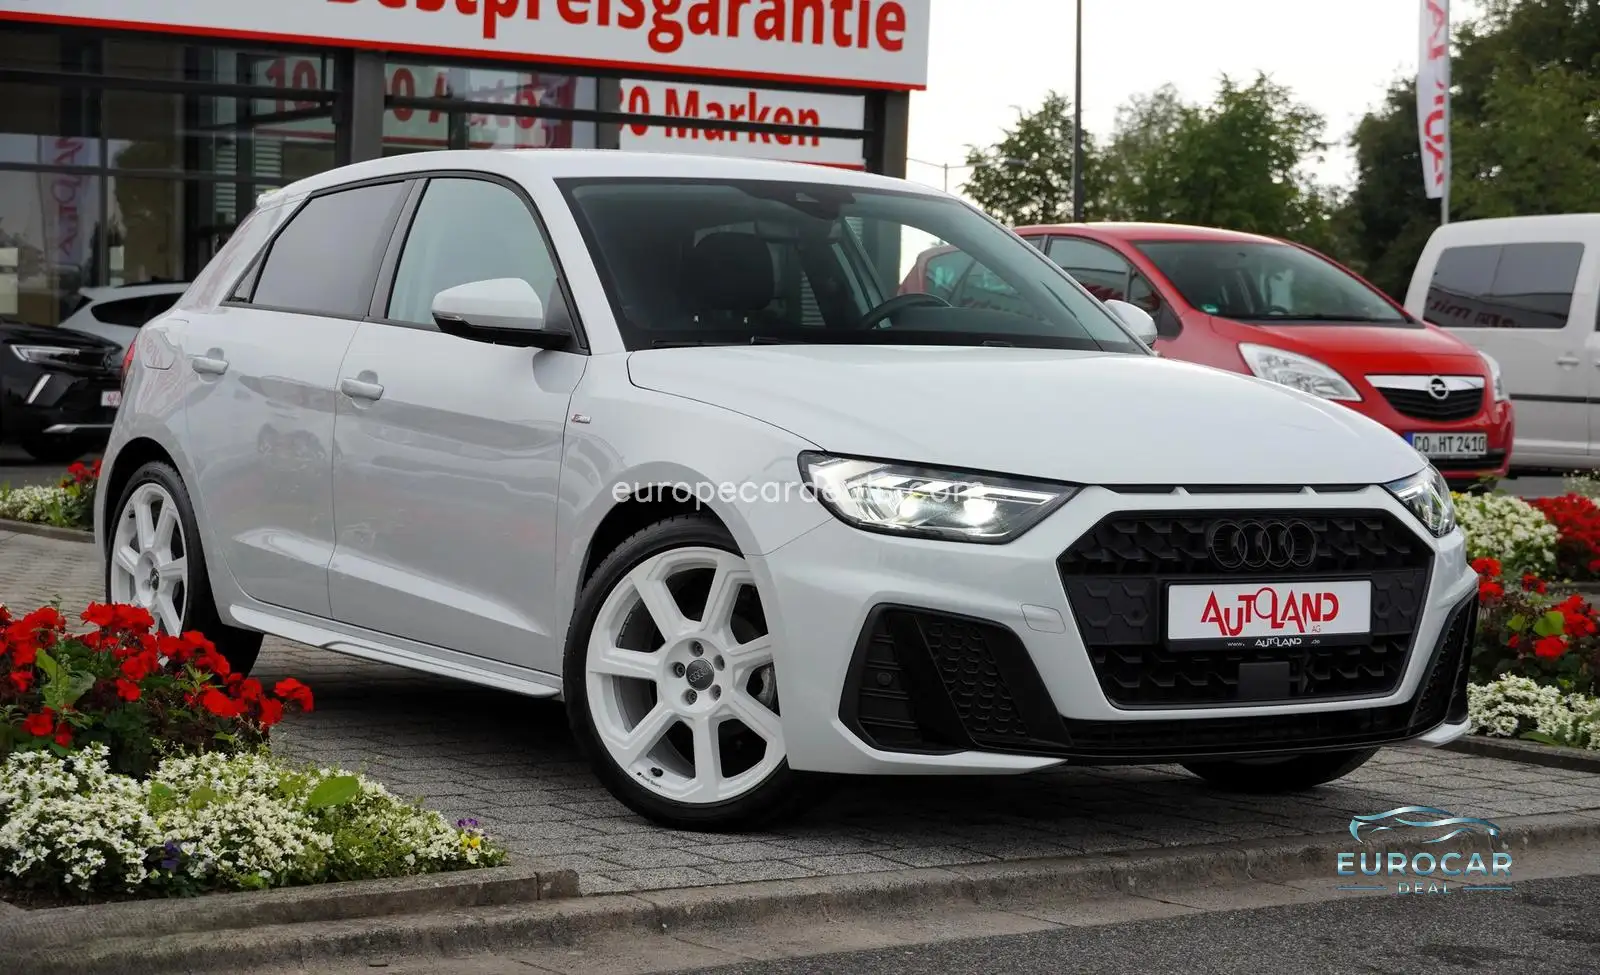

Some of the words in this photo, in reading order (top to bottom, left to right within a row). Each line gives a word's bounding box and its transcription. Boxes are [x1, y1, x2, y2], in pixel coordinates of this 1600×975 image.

[619, 86, 650, 136] 0
[665, 87, 821, 147] Marken
[1440, 436, 1454, 452] HT
[1456, 435, 1486, 452] 2410
[1200, 586, 1339, 637] AUTOLAND
